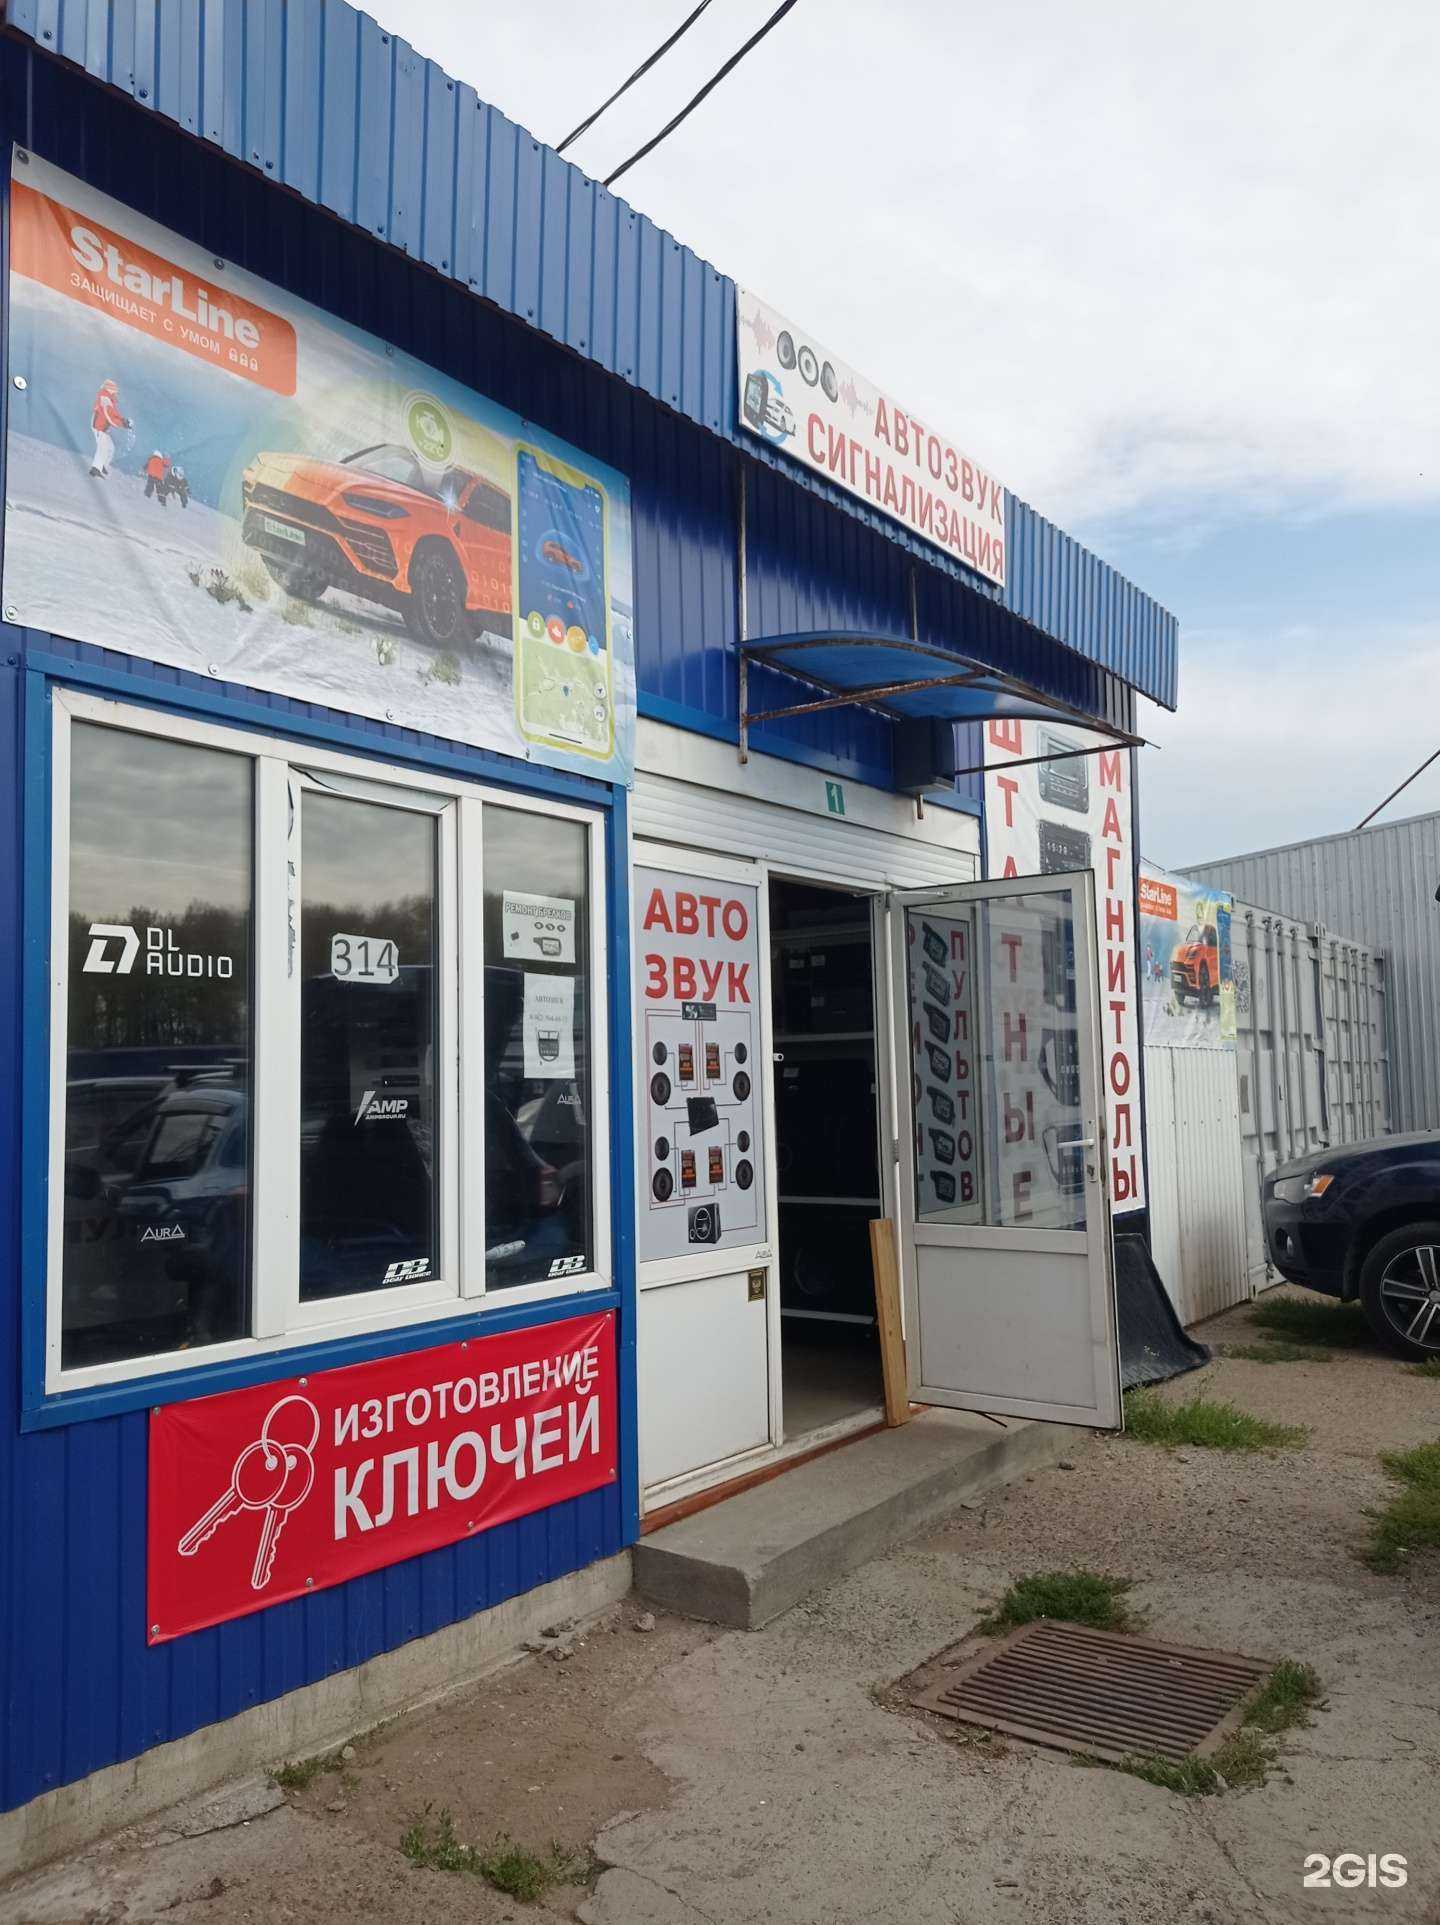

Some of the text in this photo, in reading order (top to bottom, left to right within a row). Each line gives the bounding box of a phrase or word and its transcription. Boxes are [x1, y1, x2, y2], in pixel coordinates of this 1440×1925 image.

[70, 226, 261, 350] StarLine
[70, 272, 221, 355] ЗАЩИЩАЕТ С УМОМ
[874, 397, 1003, 525] АВТОЗВУК
[807, 413, 1004, 580] СИГНАЛИЗАЦИЯ
[830, 783, 841, 814] 1
[504, 901, 536, 916] РЕМОНТ
[643, 888, 748, 942] АВТО
[1140, 883, 1172, 907] StarLine
[146, 926, 181, 952] DL
[146, 951, 233, 979] AUDIO
[334, 938, 397, 978] 314
[644, 953, 751, 1004] ЗВУК
[1099, 744, 1137, 1202] МАГНИТОЛЫ
[950, 929, 975, 1202] ПУЛЬТОВ
[366, 1099, 409, 1114] AMP
[334, 1345, 599, 1447] ИЗГОТОВЛЕНИЕ
[334, 1380, 600, 1541] КЛЮЧЕЙ
